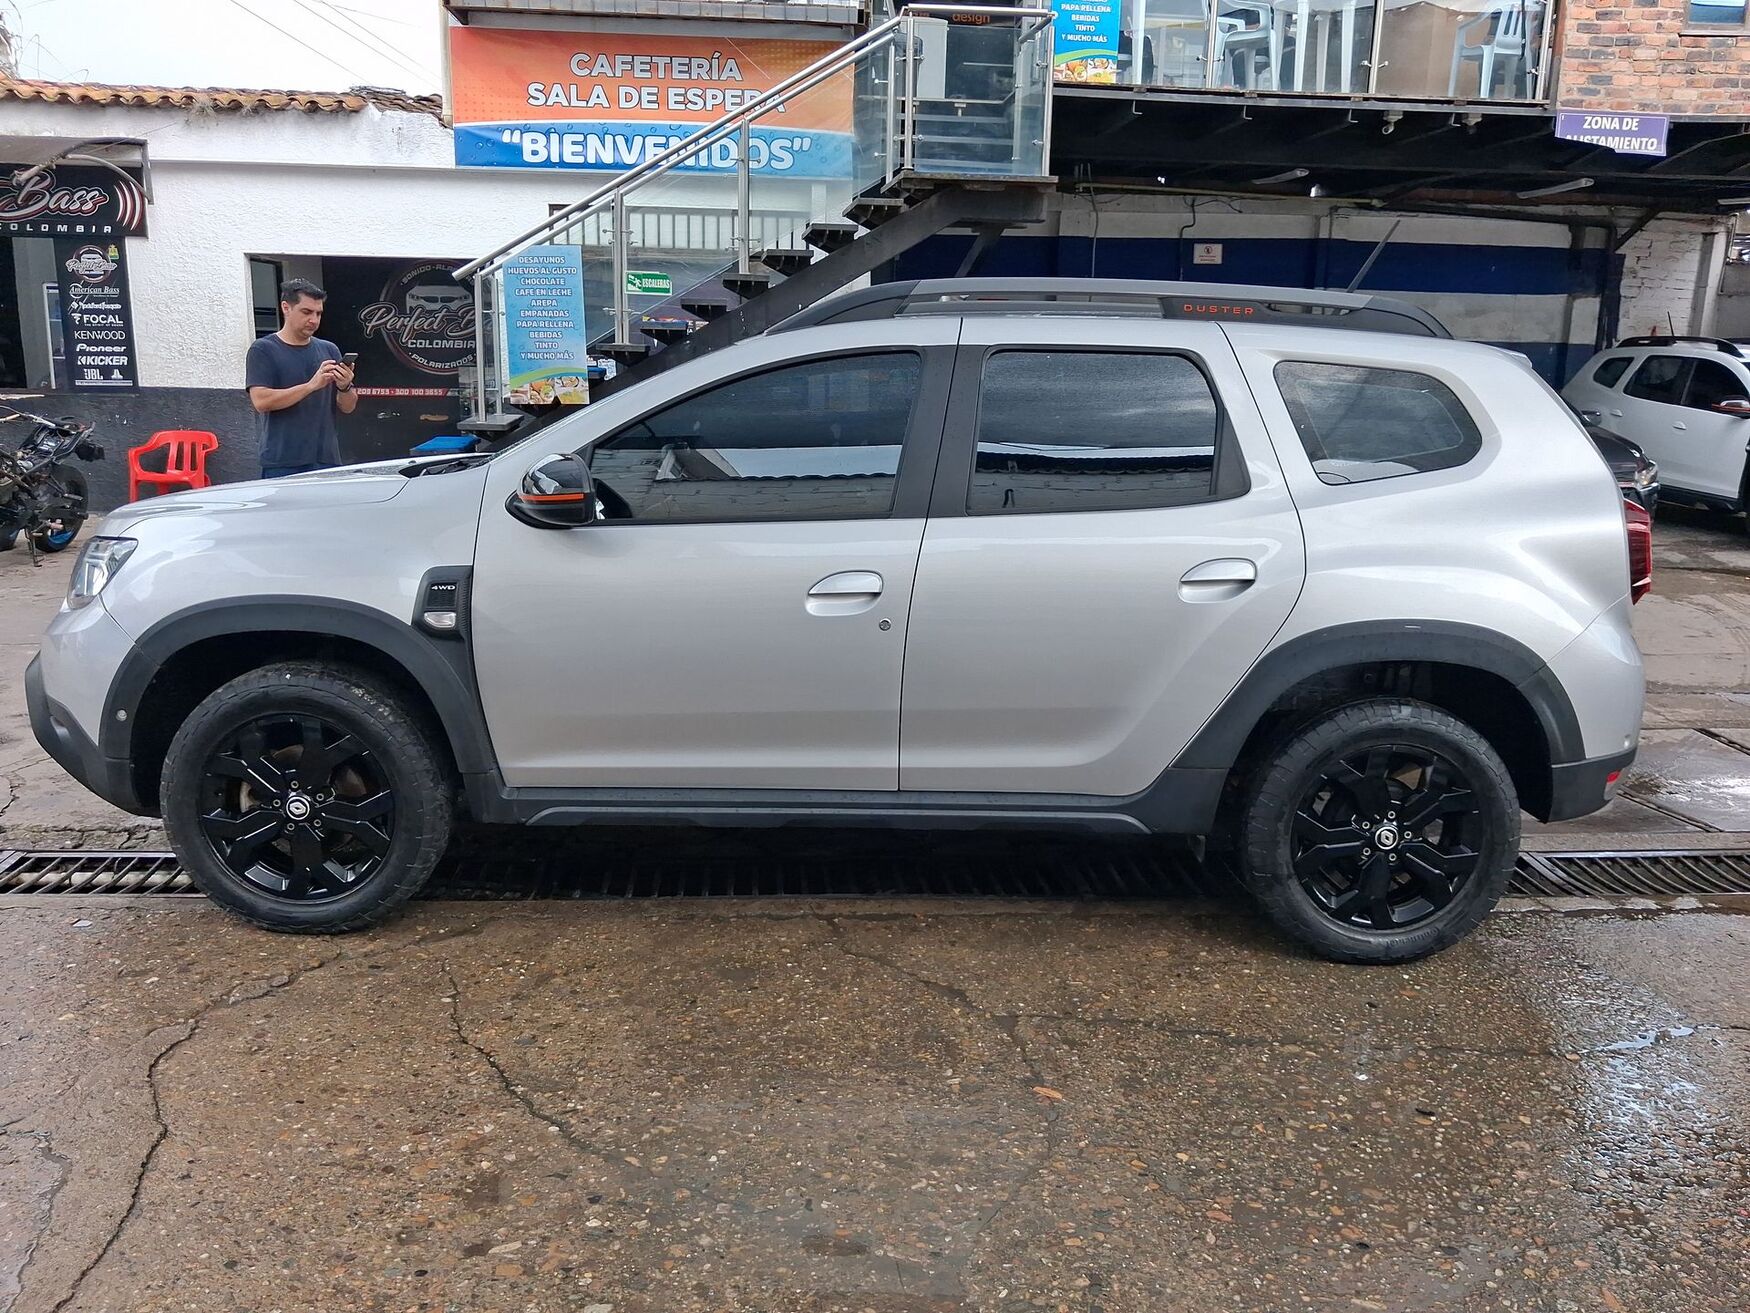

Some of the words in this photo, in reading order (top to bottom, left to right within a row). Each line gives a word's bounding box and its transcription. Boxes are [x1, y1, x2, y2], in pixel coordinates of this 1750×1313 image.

[1075, 24, 1096, 32] TINTO
[1092, 34, 1108, 42] MÁS
[570, 51, 743, 81] CAFETERÍA
[527, 82, 611, 108] SALA
[618, 85, 660, 110] DE
[1583, 116, 1620, 130] ZONA
[1622, 118, 1640, 131] DE
[0, 222, 112, 233] OLOMBIA
[518, 256, 565, 264] DESAYUNOS
[642, 278, 670, 289] ESCALERAS
[69, 286, 102, 294] American
[104, 286, 120, 294] Bass
[515, 288, 534, 296] CAFE
[536, 288, 546, 296] EN
[548, 288, 572, 296] LECHE
[531, 299, 558, 307] AREPA
[1183, 304, 1254, 315] DUSTER
[83, 314, 123, 323] FOCAL
[360, 303, 445, 344] Perfect
[74, 330, 126, 340] KENWOOD
[76, 343, 127, 352] Pioneer
[407, 340, 476, 349] COLOMBIA
[527, 352, 555, 360] MUCHO
[556, 350, 574, 359] MÁS
[86, 356, 128, 366] KICKER
[411, 353, 474, 369] POLARIZADOS
[84, 368, 103, 380] JBL
